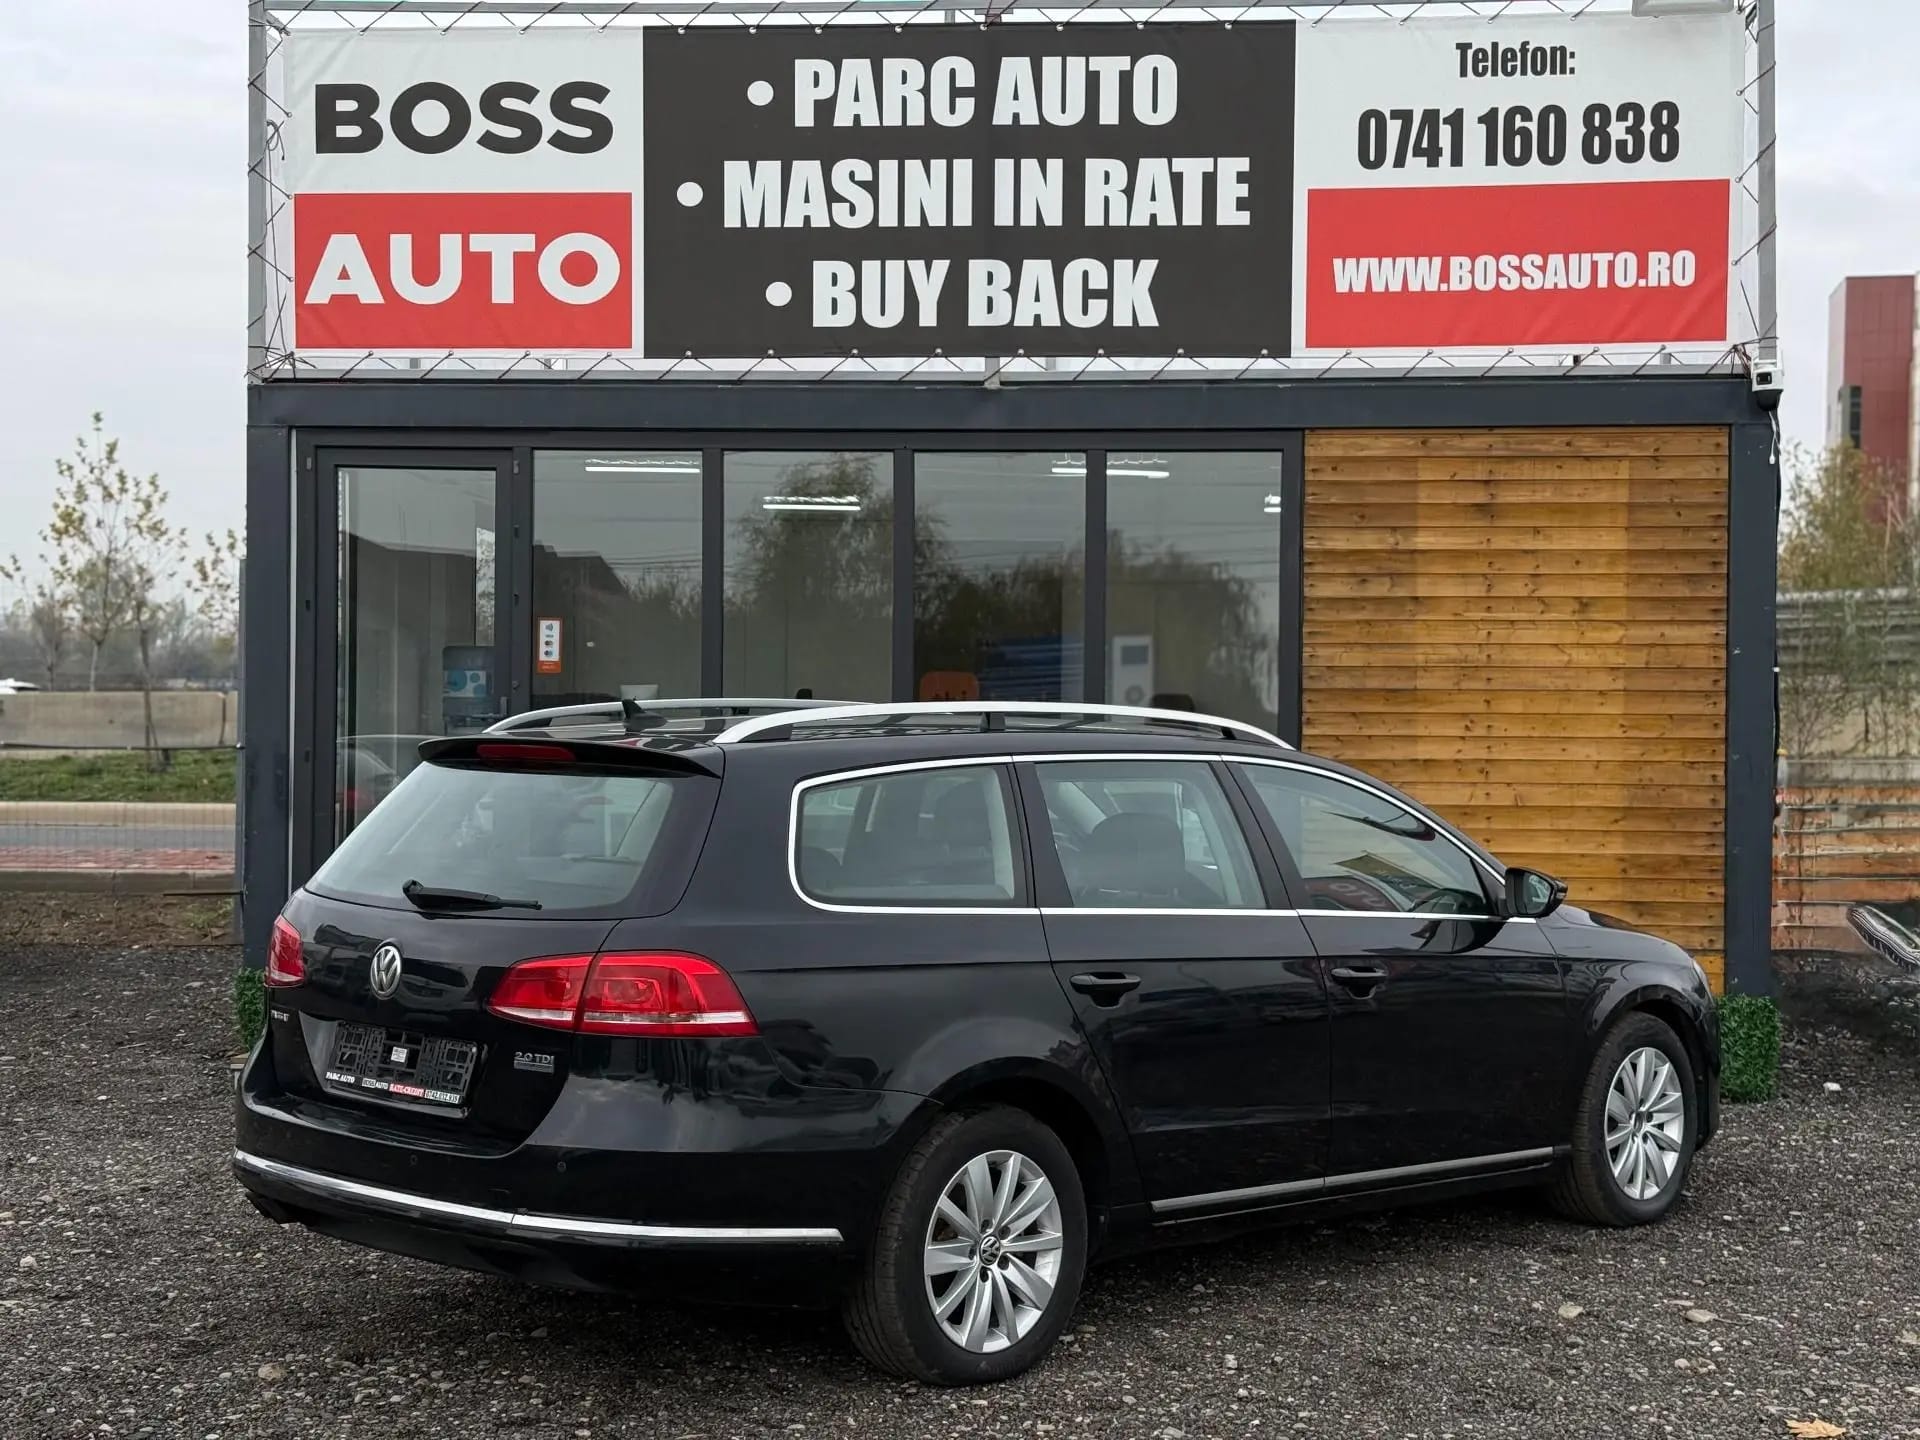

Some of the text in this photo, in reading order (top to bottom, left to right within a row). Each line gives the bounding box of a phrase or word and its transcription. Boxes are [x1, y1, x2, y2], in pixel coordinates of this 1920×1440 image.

[794, 55, 1178, 127] PARC AUTO
[1455, 41, 1577, 78] Telefon:
[314, 81, 614, 155] BOSS
[1357, 101, 1680, 170] 0741 160 838
[723, 157, 1251, 228] MASINI IN RATE
[303, 232, 622, 305] AUTO
[812, 258, 1160, 328] BUY BACK
[1332, 250, 1696, 293] WWW.BOSSAUTO.RO
[340, 1074, 355, 1084] AUTO
[534, 1053, 555, 1065] TDI
